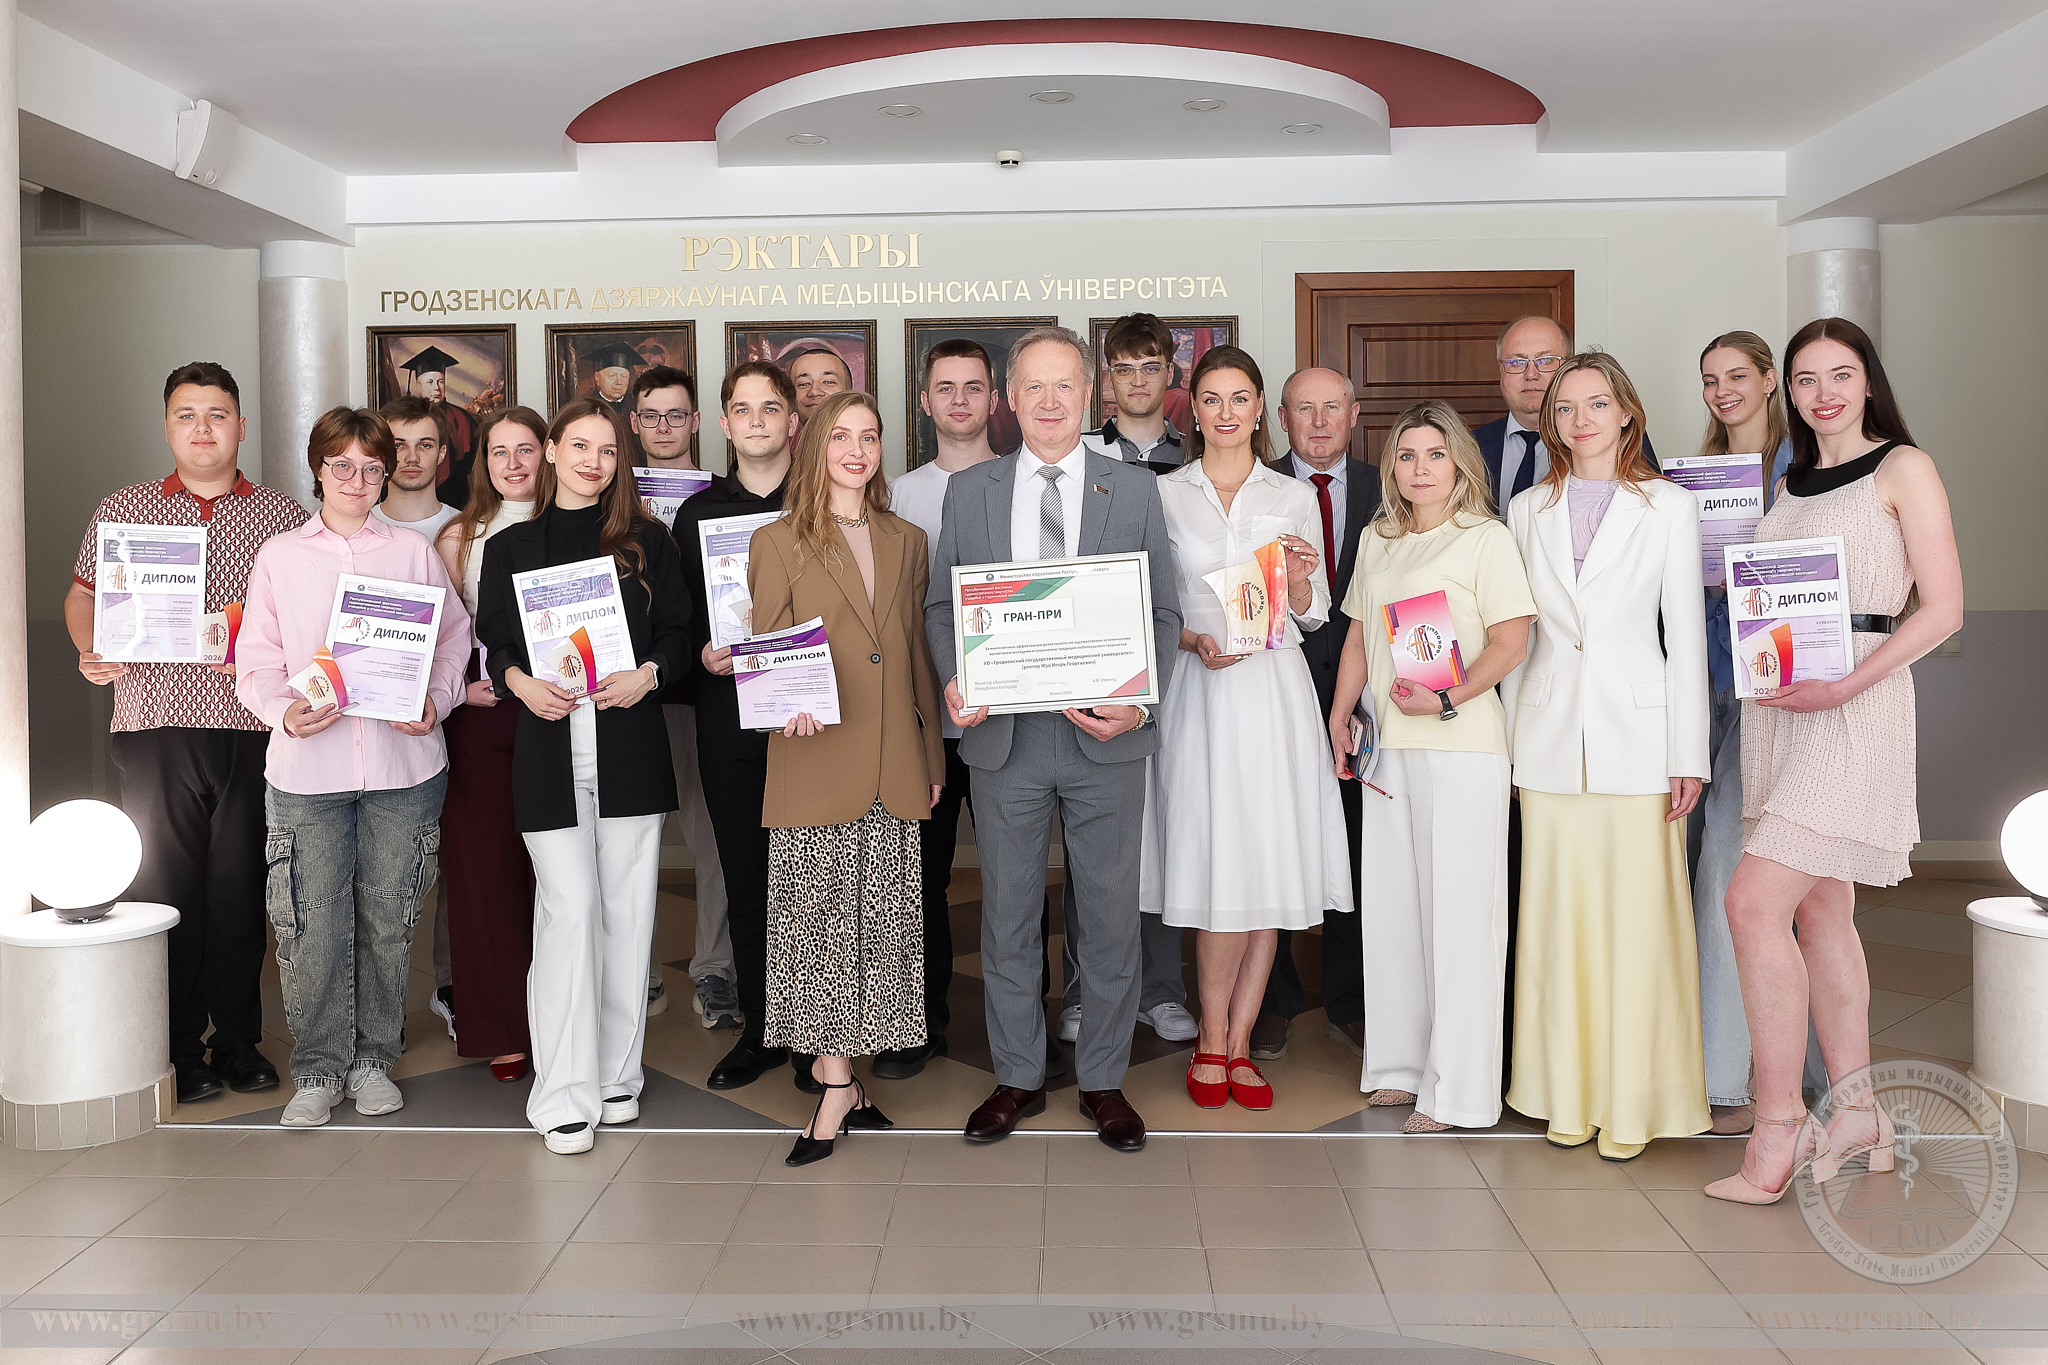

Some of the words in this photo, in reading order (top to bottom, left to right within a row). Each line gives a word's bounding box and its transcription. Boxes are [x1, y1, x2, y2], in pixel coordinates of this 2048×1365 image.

[681, 233, 923, 272] РЭКТАРЫ
[380, 287, 582, 316] ГРОДЗЕНСКАГА
[589, 280, 788, 313] ДЗЯРЖАЎНАГА
[797, 279, 1032, 309] МЕДЫЦЫНСКАГА
[1039, 273, 1228, 301] ЎНІВЕРСІТЭТА
[1703, 497, 1758, 511] ДИПЛОМ
[141, 573, 196, 585] ДИПЛОМ
[1777, 591, 1839, 608] ДИПЛОМ
[565, 605, 617, 626] ДИПЛОМ
[1003, 609, 1062, 622] ГРАН-ПРИ
[373, 627, 426, 643] ДИПЛОМ
[1232, 636, 1261, 648] 2026
[773, 651, 826, 664] ДИПЛОМ
